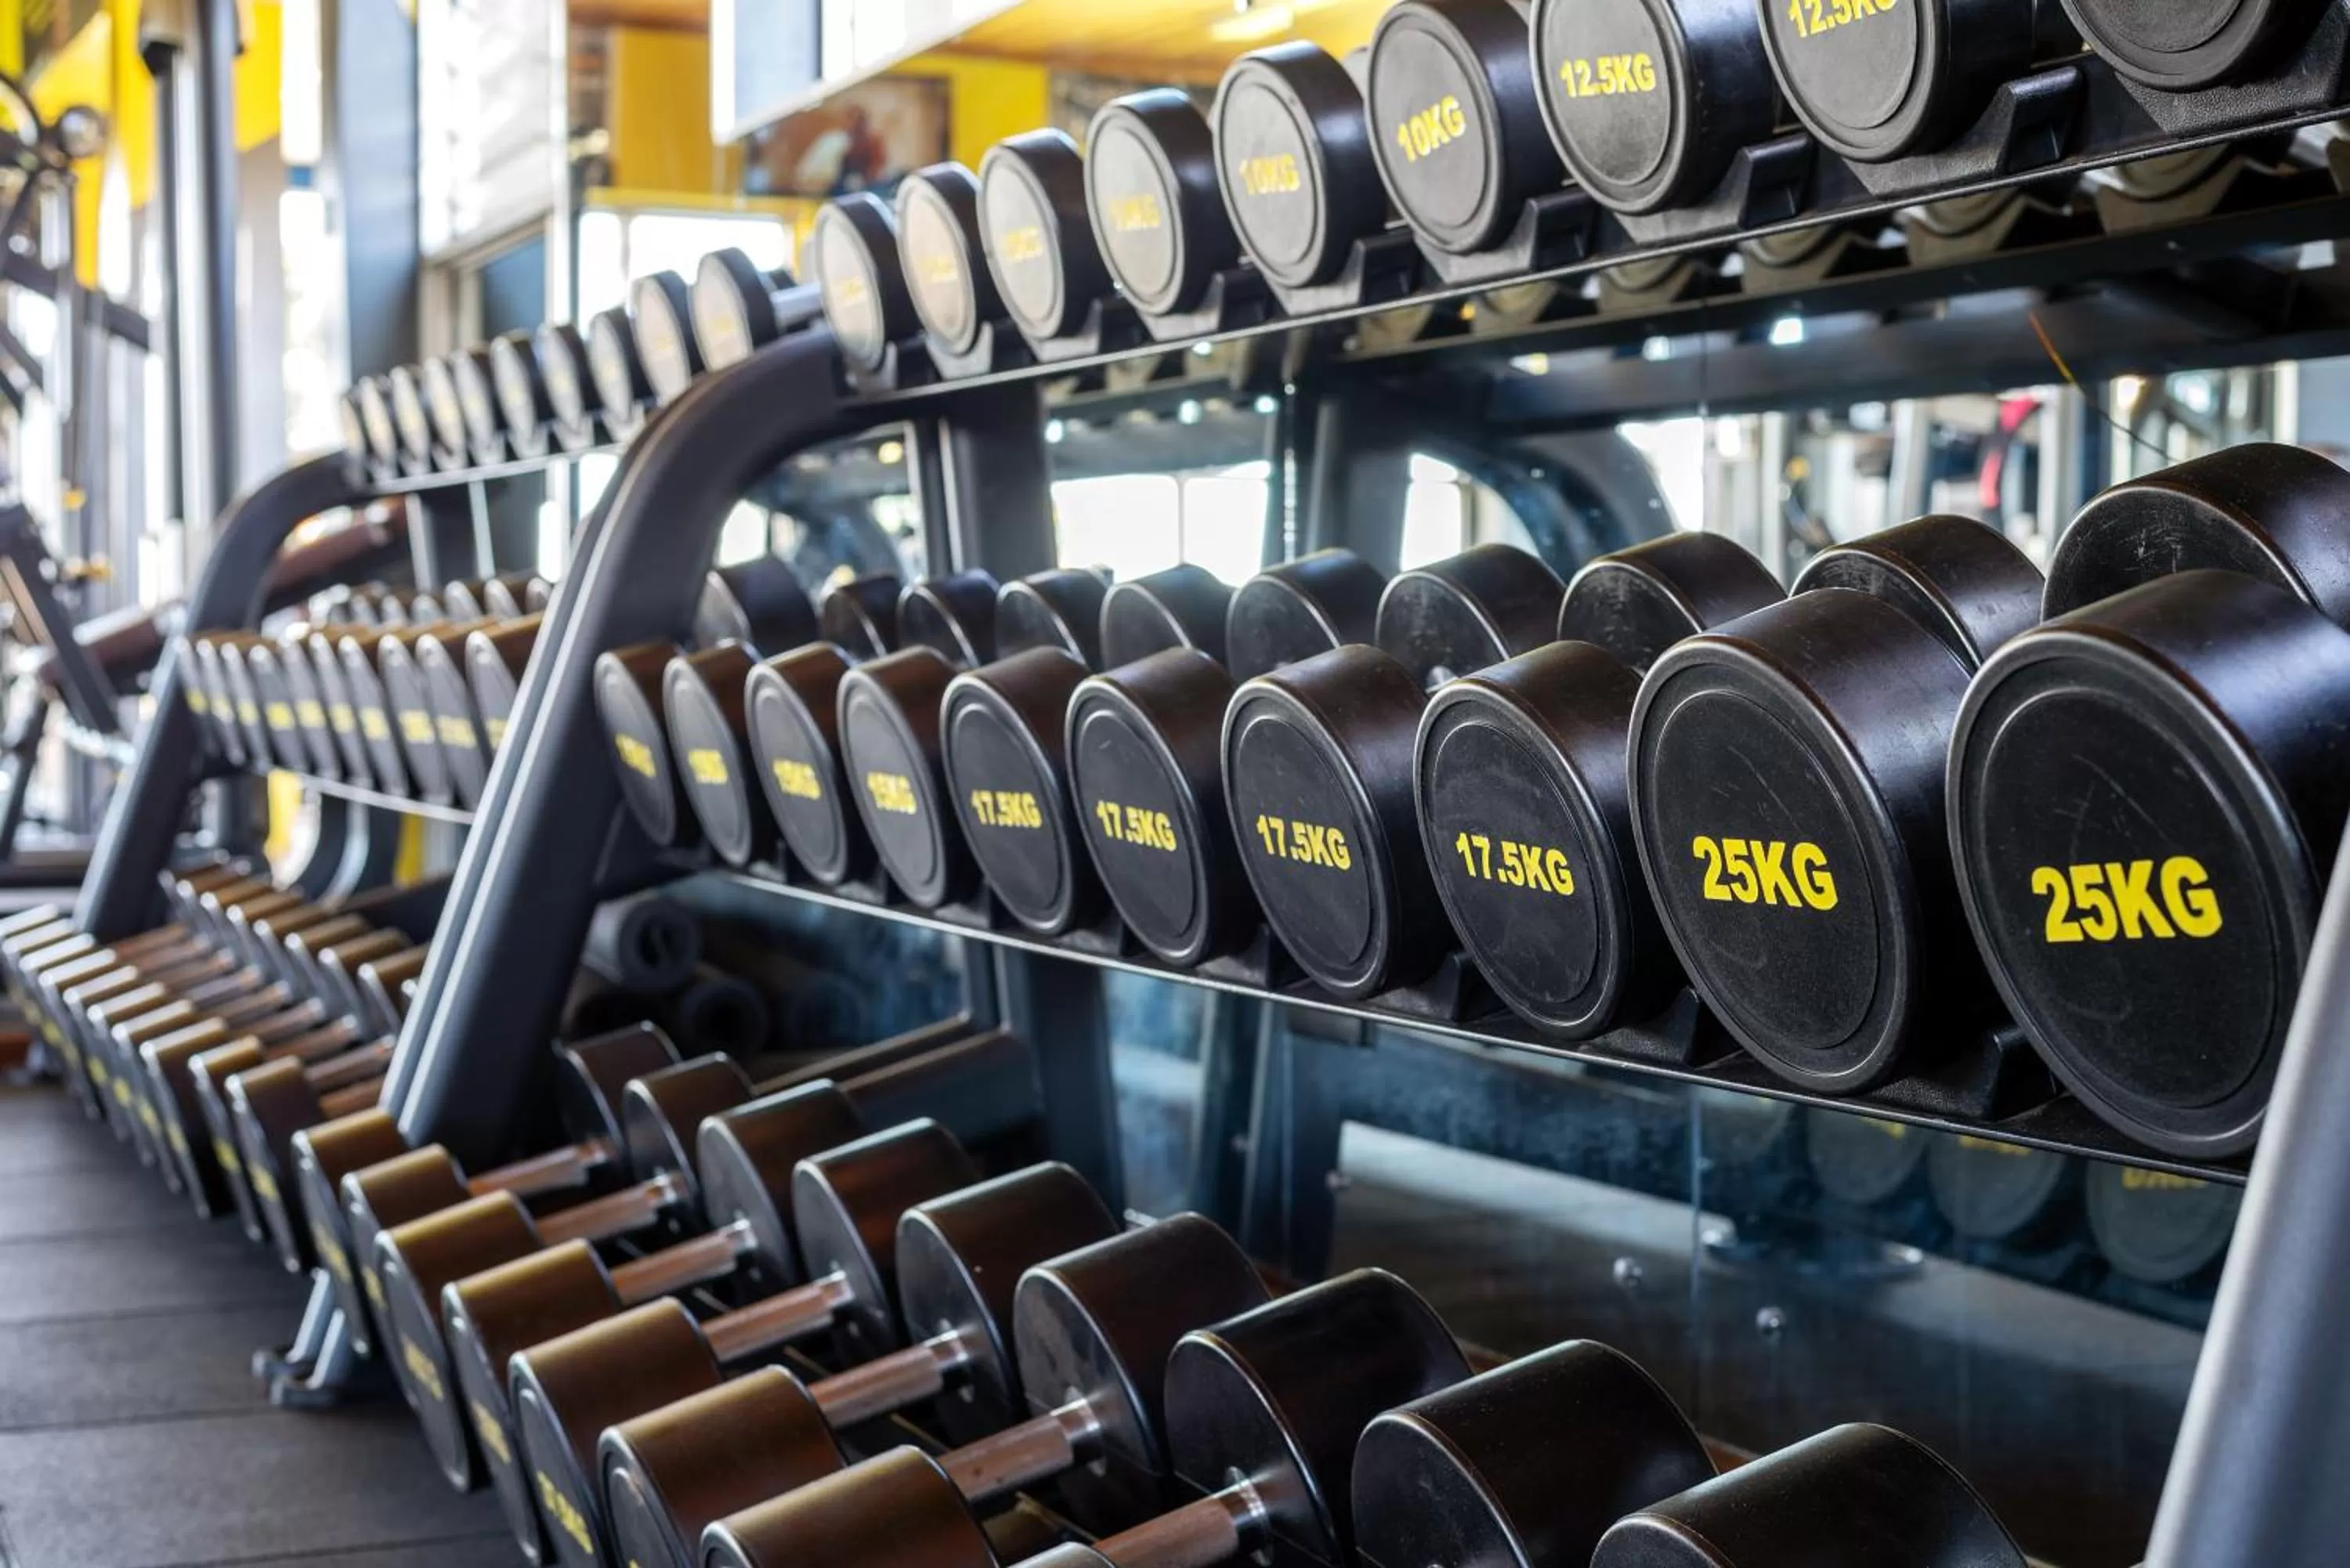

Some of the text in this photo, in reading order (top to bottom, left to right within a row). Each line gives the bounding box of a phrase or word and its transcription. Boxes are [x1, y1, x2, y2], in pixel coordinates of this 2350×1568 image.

[1788, 0, 1899, 38] 12.5
[1560, 52, 1656, 98] 12.5KG
[1397, 94, 1467, 164] 10KG
[971, 790, 1042, 829] 17.5KG
[1097, 800, 1177, 851] 17.5KG
[1256, 814, 1351, 871] 17.5KG
[1455, 832, 1575, 896] 17.5KG
[1692, 835, 1838, 911] 25KG
[2030, 855, 2222, 944] 25KG
